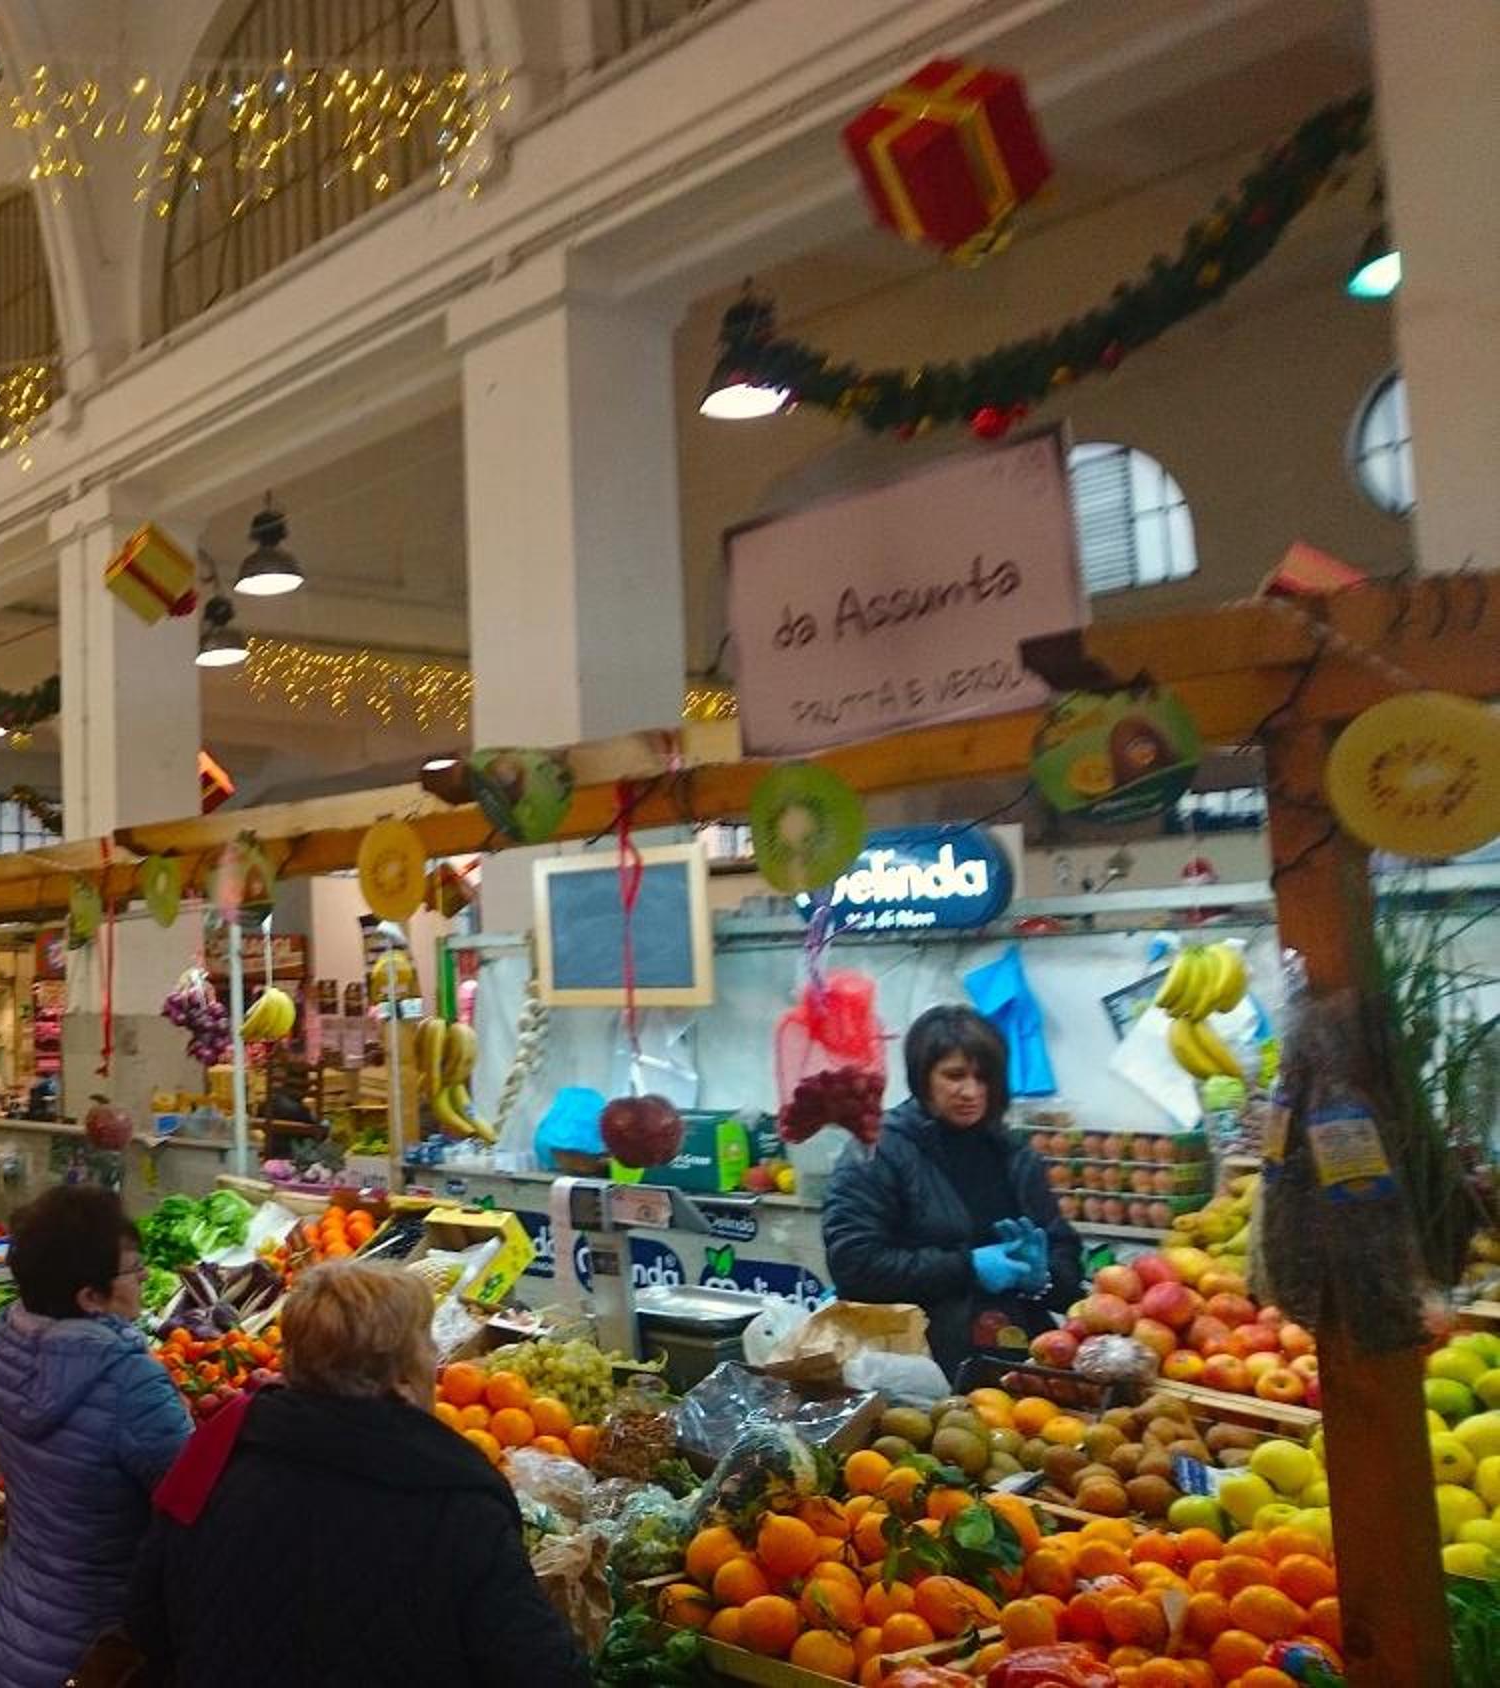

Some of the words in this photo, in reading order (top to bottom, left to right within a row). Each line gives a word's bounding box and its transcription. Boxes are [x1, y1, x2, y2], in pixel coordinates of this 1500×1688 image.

[773, 604, 818, 651] da
[834, 554, 1023, 642] Assunta
[830, 843, 990, 908] elinda
